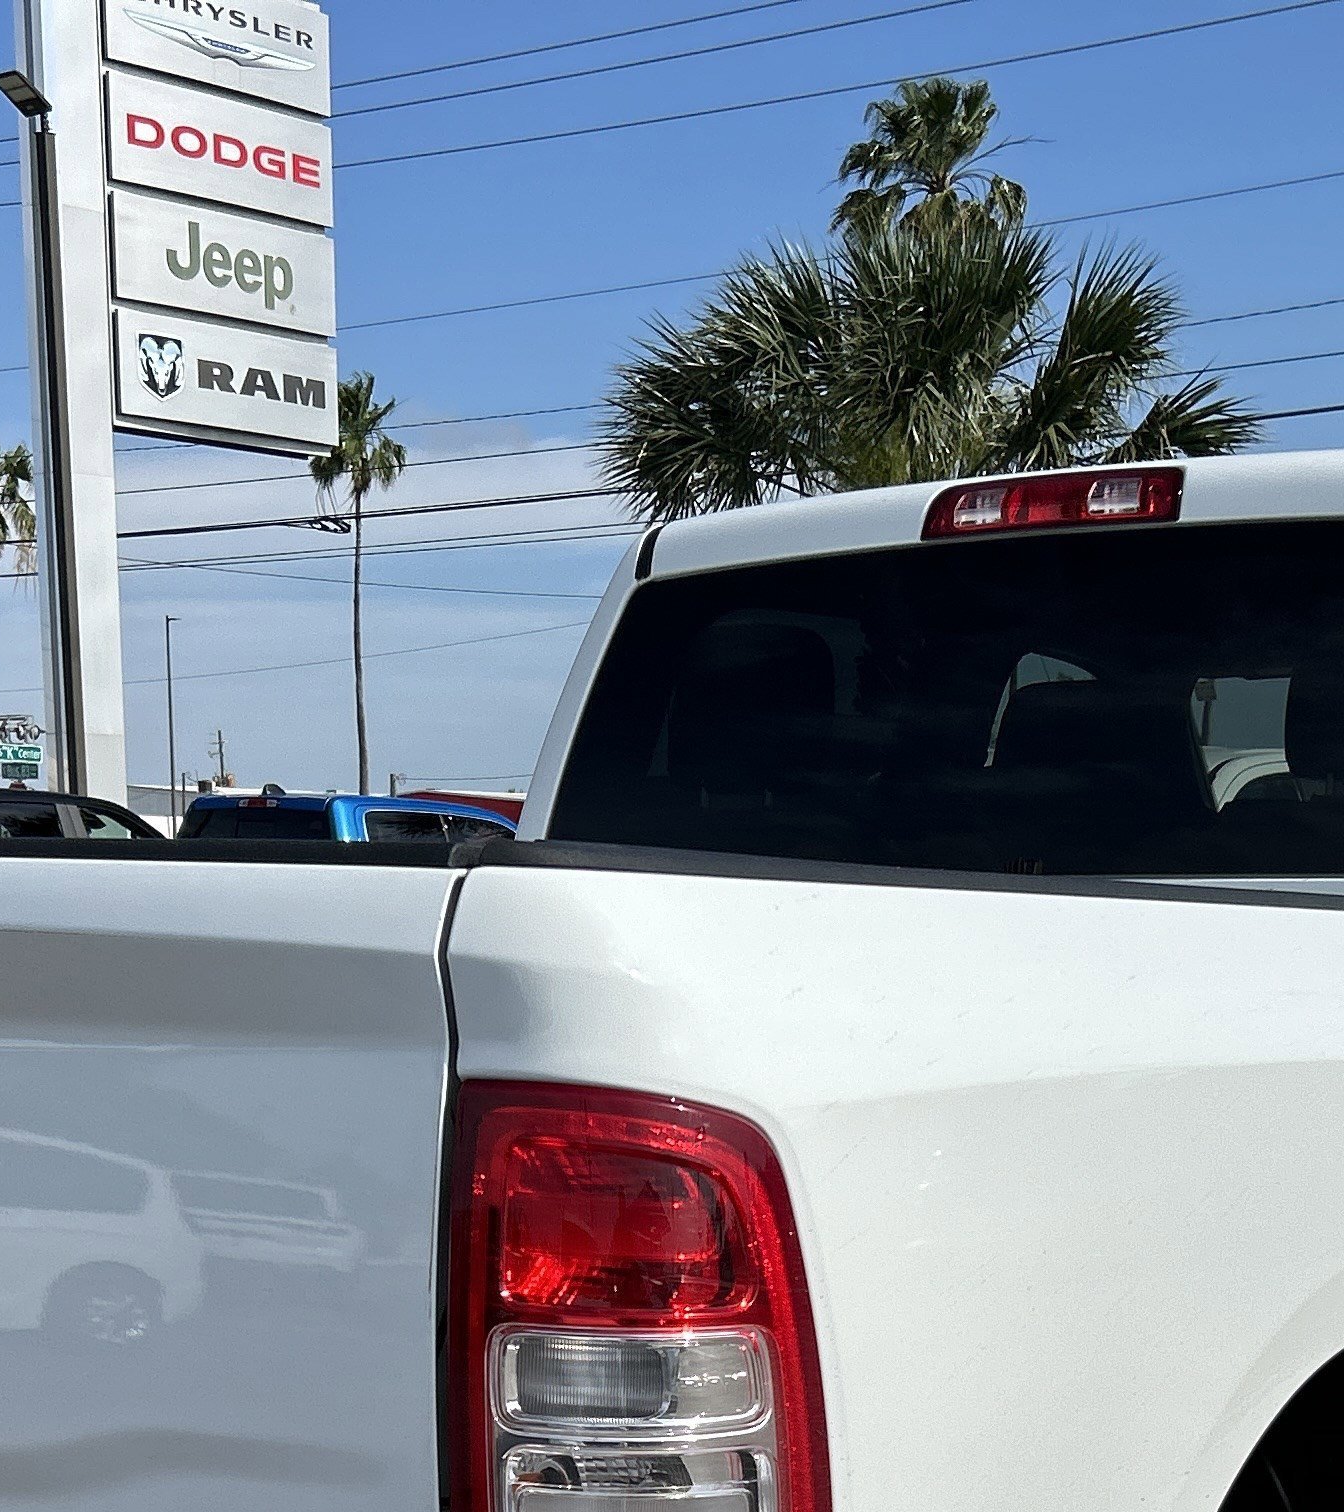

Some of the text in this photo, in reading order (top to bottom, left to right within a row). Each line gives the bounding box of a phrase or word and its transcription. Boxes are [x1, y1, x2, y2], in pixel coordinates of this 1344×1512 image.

[139, 0, 314, 50] RYSLER
[127, 113, 321, 188] DODGE
[166, 221, 294, 311] Jeep
[197, 358, 326, 410] RAM
